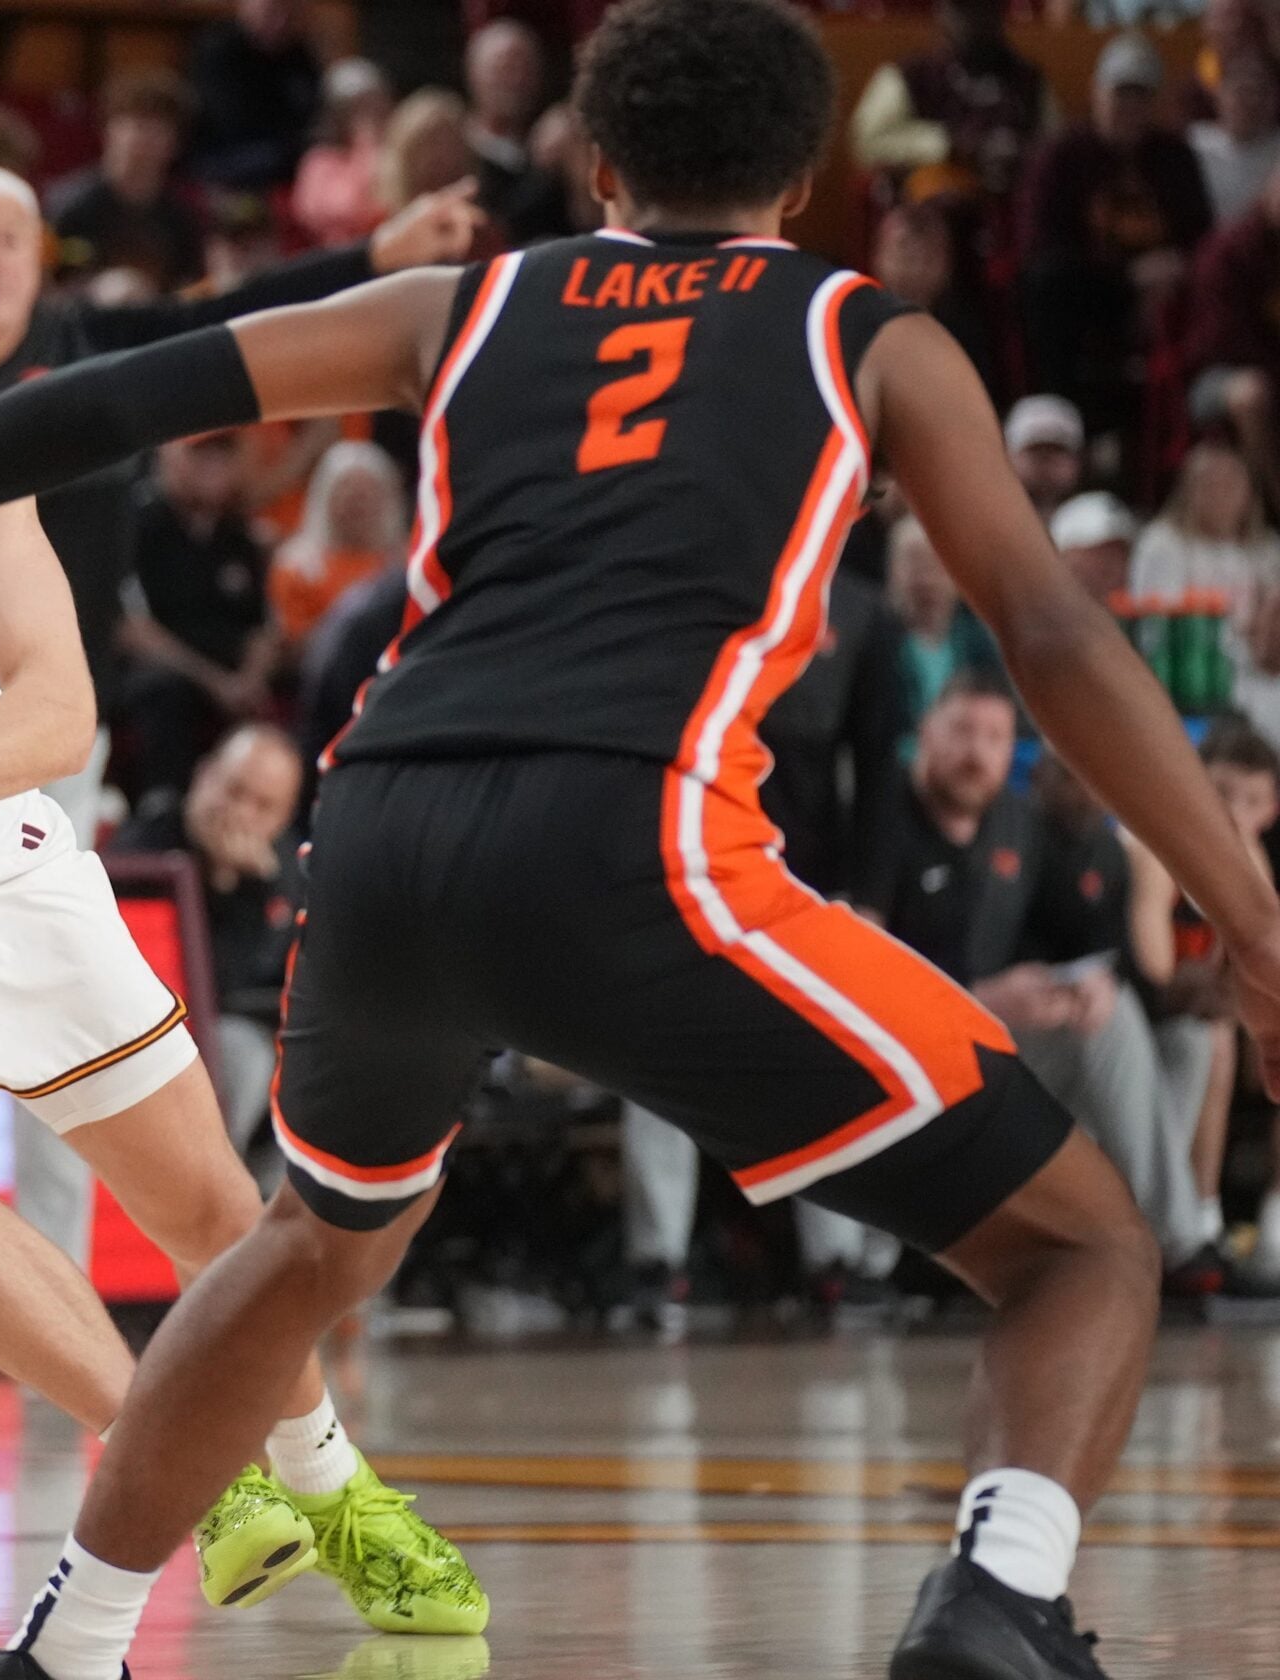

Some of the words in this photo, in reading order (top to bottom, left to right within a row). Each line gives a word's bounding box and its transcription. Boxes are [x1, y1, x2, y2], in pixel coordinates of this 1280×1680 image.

[561, 257, 718, 309] LAKE
[718, 254, 769, 292] II
[576, 316, 696, 475] 2
